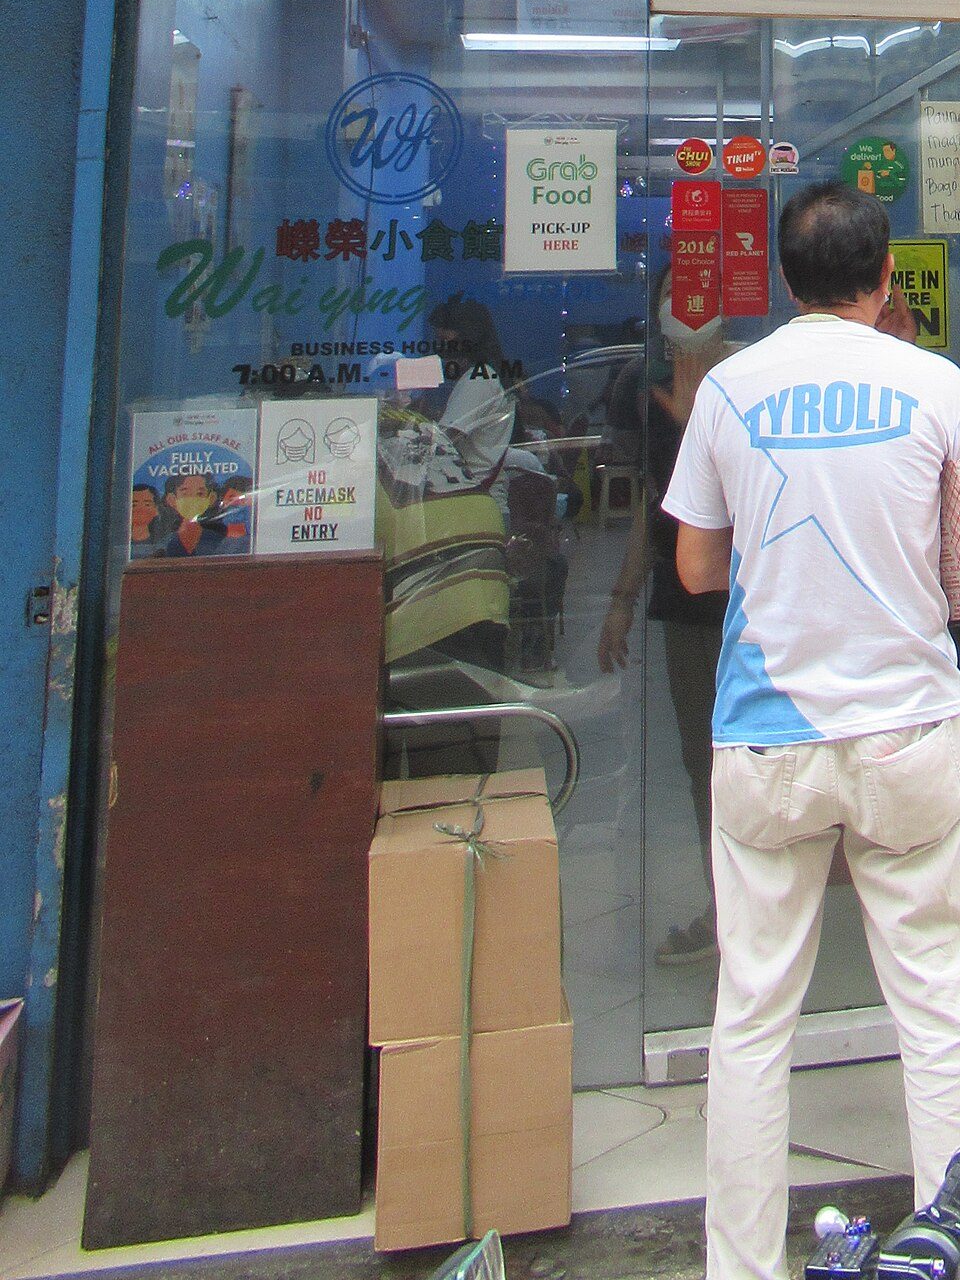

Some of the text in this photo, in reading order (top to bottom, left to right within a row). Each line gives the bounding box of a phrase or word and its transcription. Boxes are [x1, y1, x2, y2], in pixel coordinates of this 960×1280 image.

[677, 151, 709, 161] CHUI
[726, 152, 755, 165] TIKIM
[850, 152, 882, 161] deliver!
[526, 154, 598, 181] Grab
[532, 185, 592, 204] Food
[531, 223, 591, 234] PICK-UP
[543, 240, 579, 251] HERE
[156, 238, 431, 332] Wai ying
[921, 270, 939, 289] IN
[290, 340, 395, 357] BUSINESS
[744, 381, 919, 449] TYROLIT
[167, 434, 189, 446] OUR
[191, 432, 222, 442] STAFF
[222, 436, 242, 451] ARE
[171, 451, 214, 464] FULLY
[149, 462, 239, 478] VACCINATED
[307, 469, 327, 485] NO
[276, 486, 356, 505] FACEMASK
[304, 505, 324, 521] NO
[291, 523, 339, 541] ENTRY
